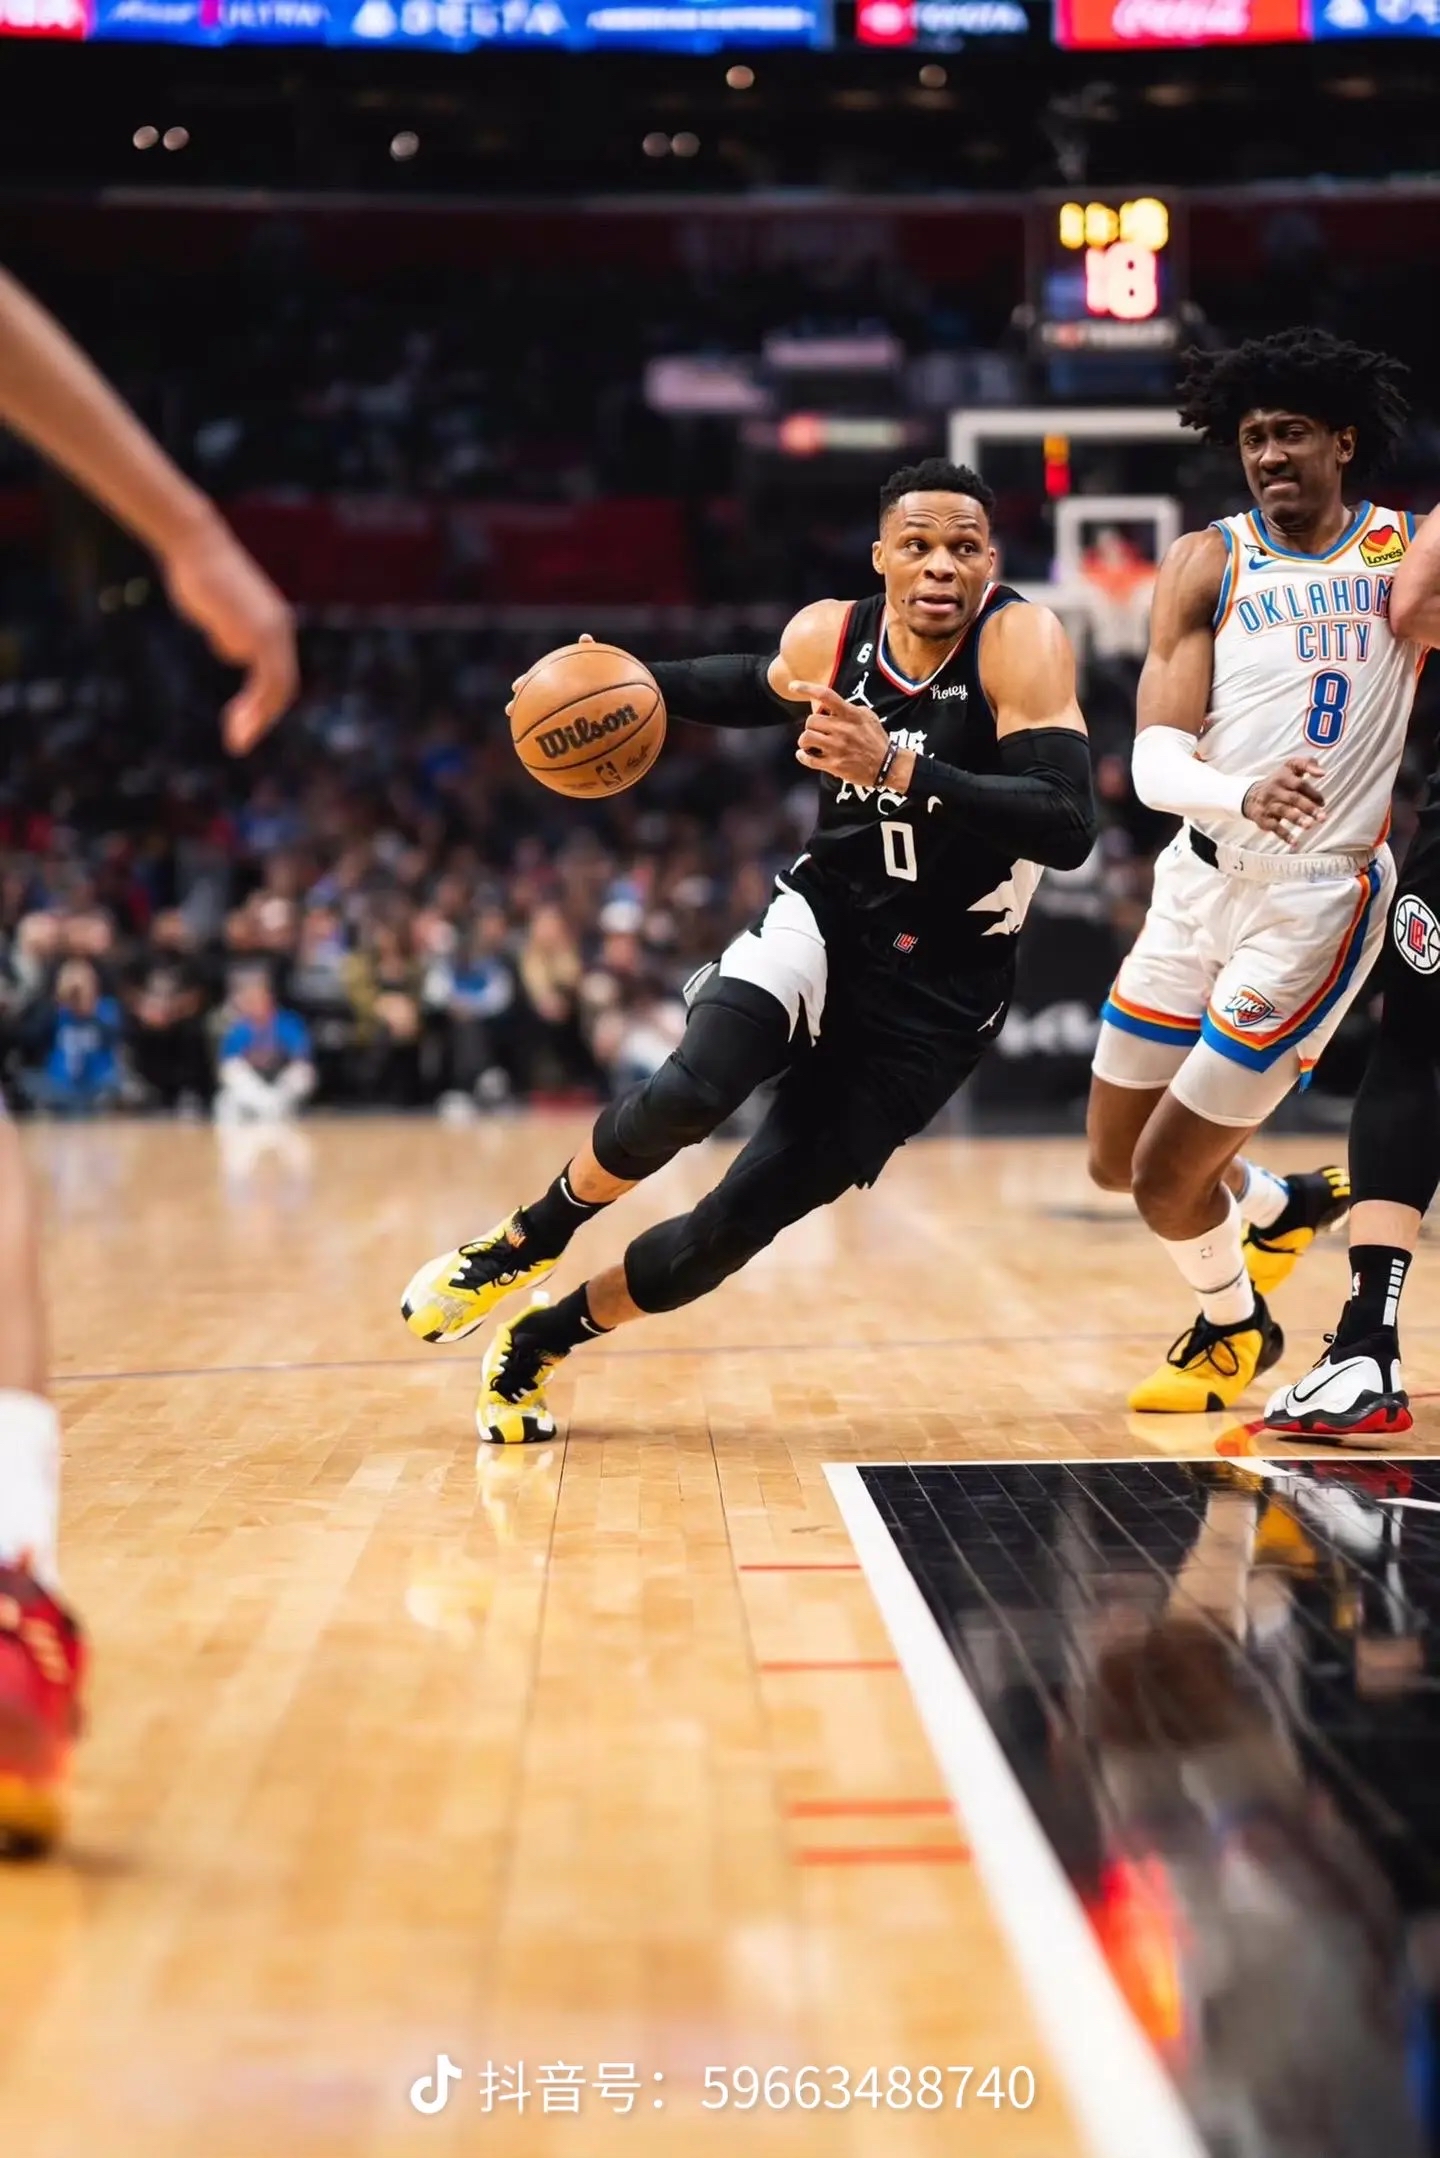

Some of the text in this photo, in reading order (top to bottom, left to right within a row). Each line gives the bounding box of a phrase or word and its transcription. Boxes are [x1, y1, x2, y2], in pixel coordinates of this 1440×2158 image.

[1085, 240, 1158, 320] 18
[1236, 573, 1396, 634] OKLAHOM
[857, 643, 873, 664] 6
[1295, 620, 1372, 662] CITY
[535, 704, 639, 759] Wilson
[1303, 668, 1351, 748] 8
[880, 821, 918, 882] 0
